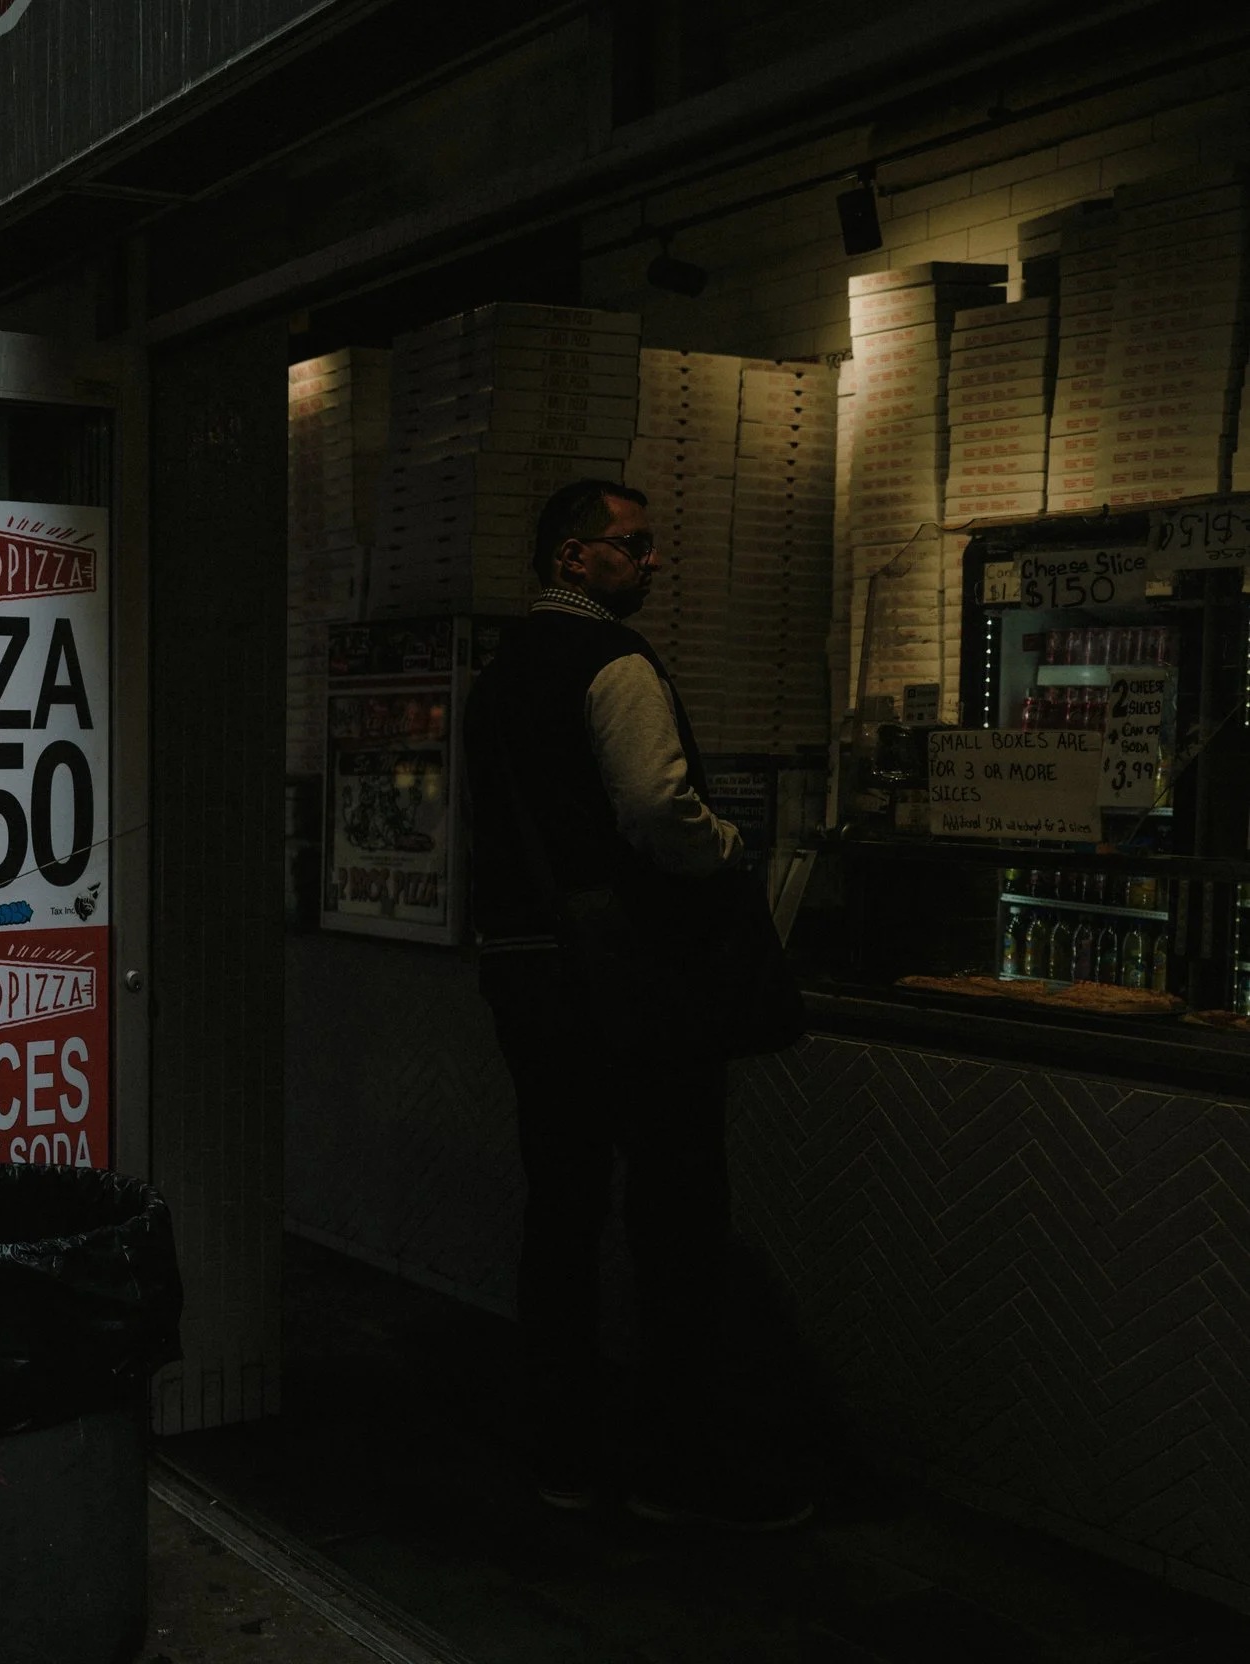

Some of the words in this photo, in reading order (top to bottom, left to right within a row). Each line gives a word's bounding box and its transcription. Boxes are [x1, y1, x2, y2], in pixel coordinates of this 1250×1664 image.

[8, 543, 83, 592] PIZZA
[1022, 558, 1089, 579] Cheese
[1094, 552, 1146, 576] Slice
[1112, 679, 1128, 718] 2
[930, 732, 983, 752] SMALL
[992, 732, 1048, 750] BOXES
[1057, 732, 1090, 751] ARE
[1121, 740, 1150, 753] SODA
[964, 761, 975, 780] 3
[984, 763, 1003, 780] OR
[1009, 763, 1058, 781] MORE
[931, 785, 982, 802] SLICES
[1057, 818, 1067, 832] 2
[50, 907, 63, 916] Tax
[8, 971, 83, 1018] PIZZA
[9, 1129, 92, 1168] SODA
